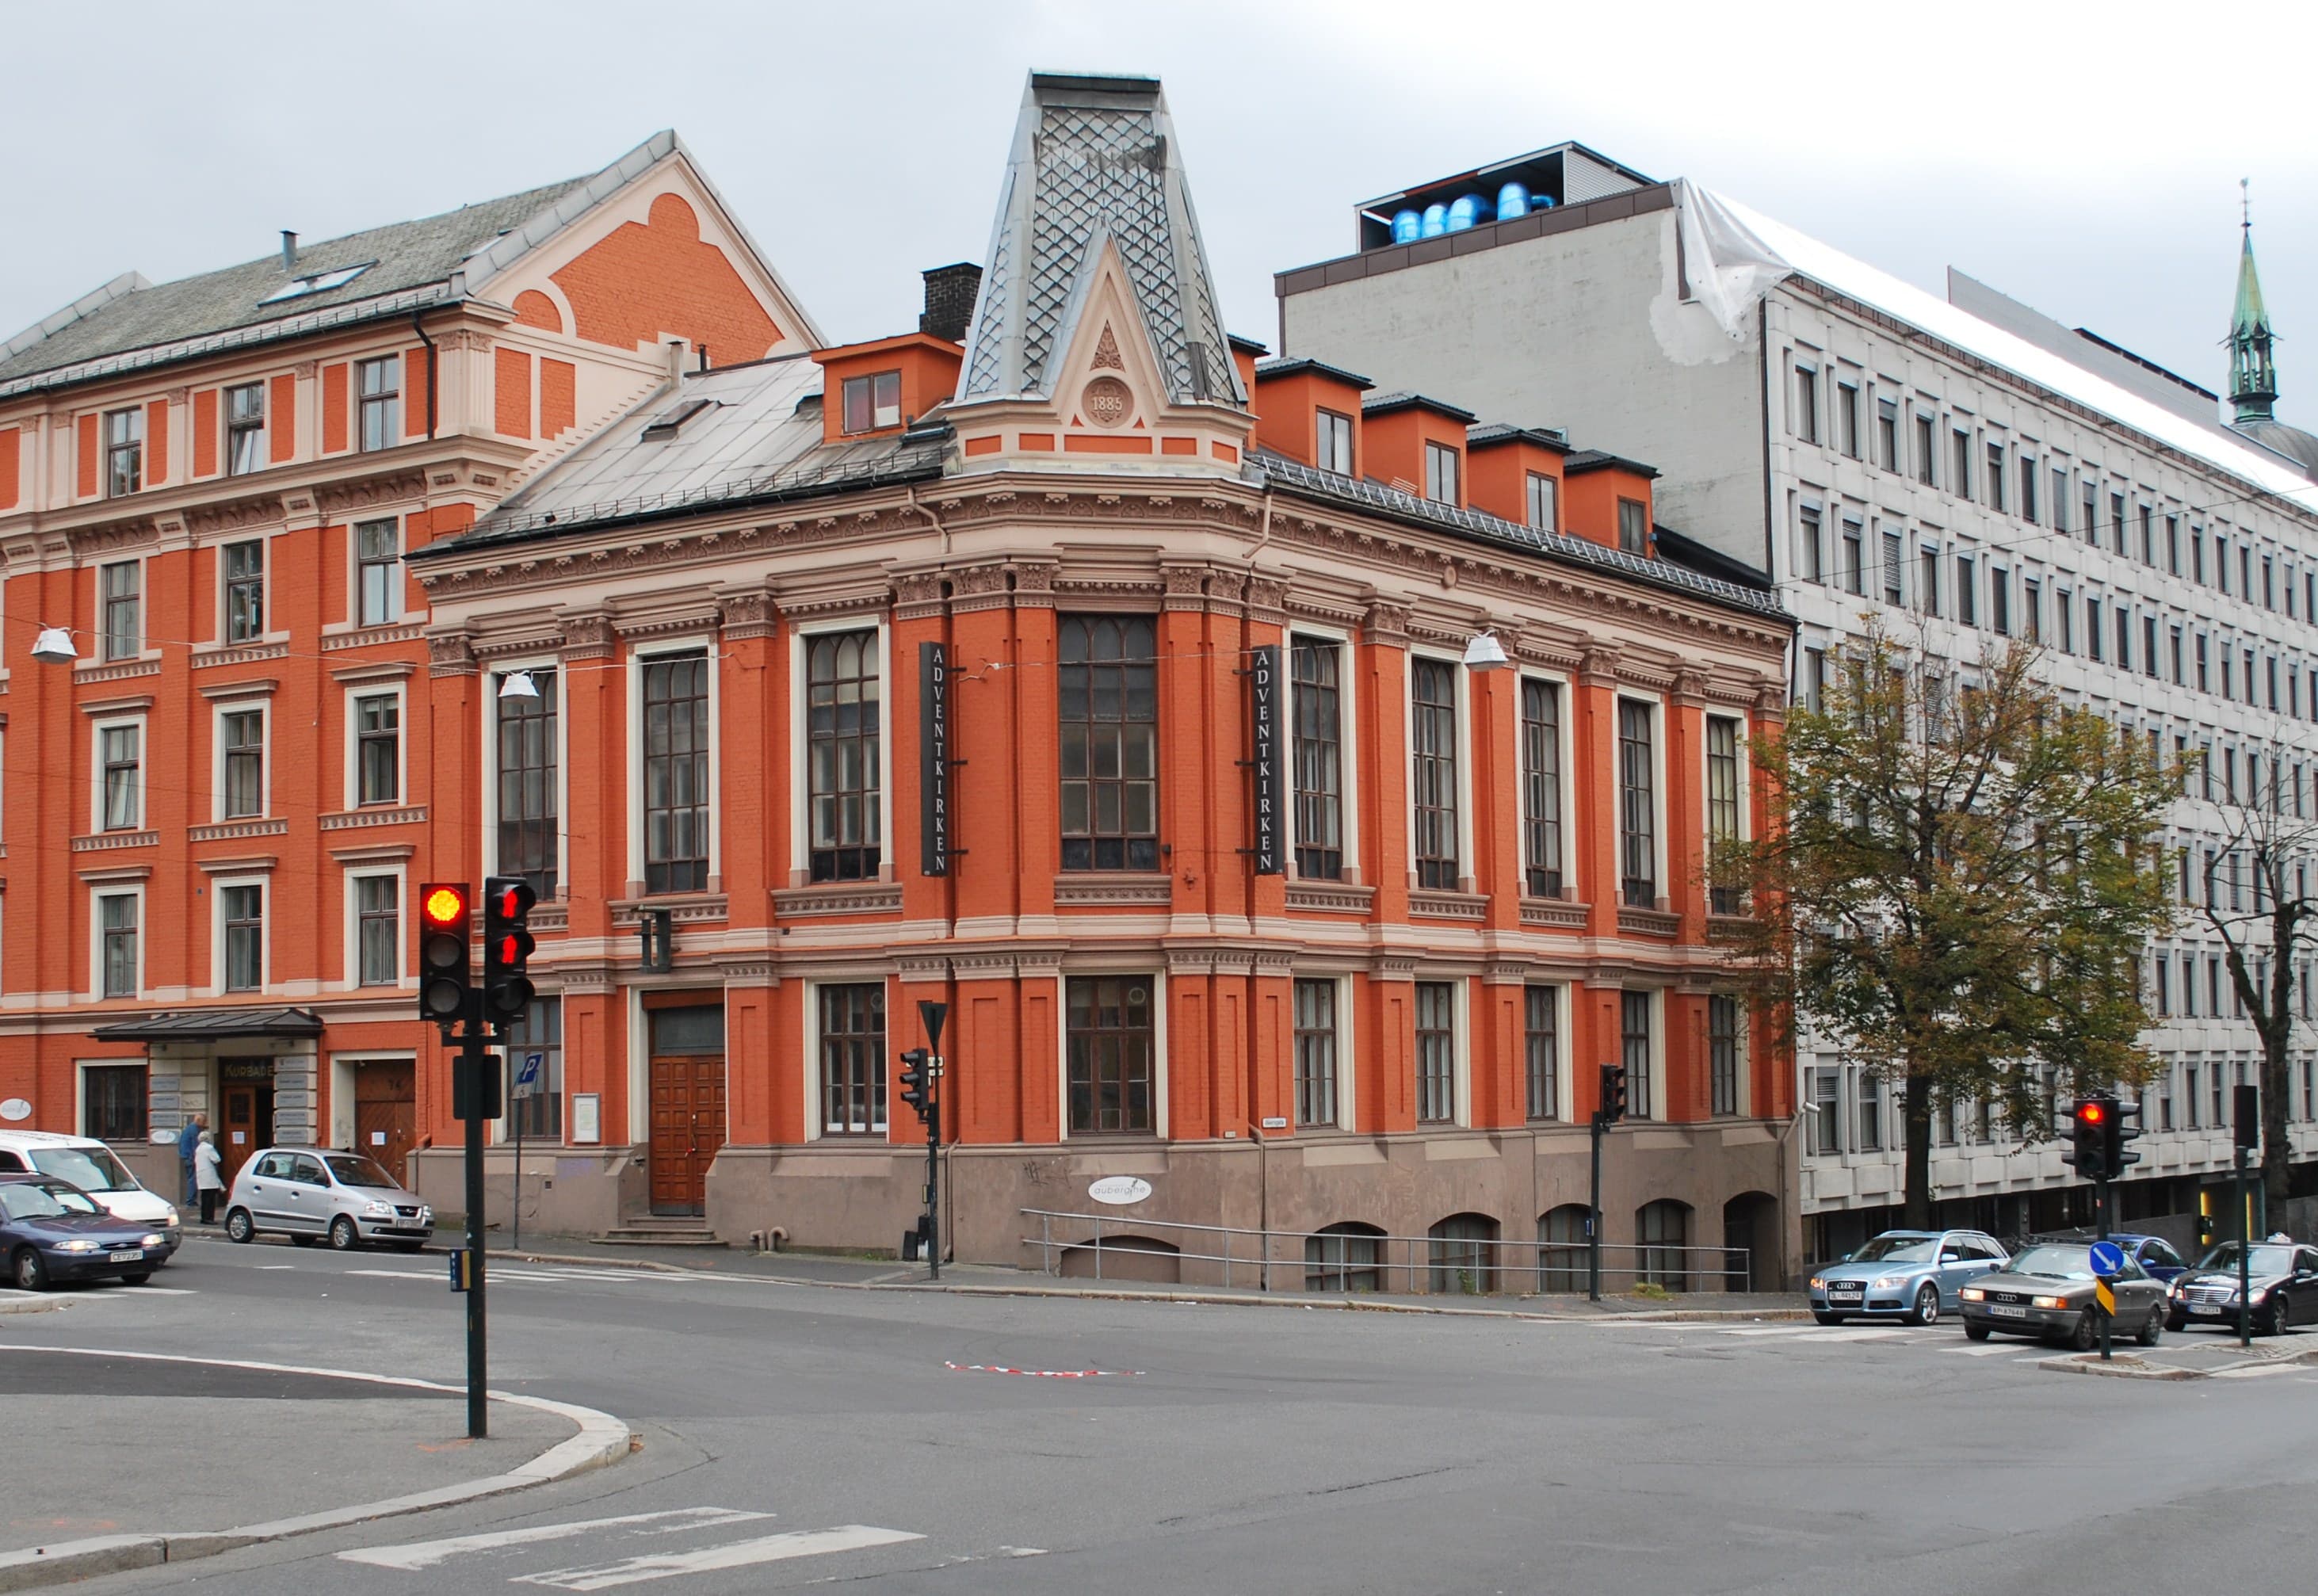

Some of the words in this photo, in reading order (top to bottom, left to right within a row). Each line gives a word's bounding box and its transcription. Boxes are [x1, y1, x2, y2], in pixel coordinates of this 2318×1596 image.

[1092, 396, 1123, 410] 1885
[933, 648, 945, 871] ADVENTKIRKEN
[1256, 650, 1272, 870] ADVENTKIRKEN
[522, 1058, 537, 1080] P
[1094, 1182, 1147, 1197] aubergine
